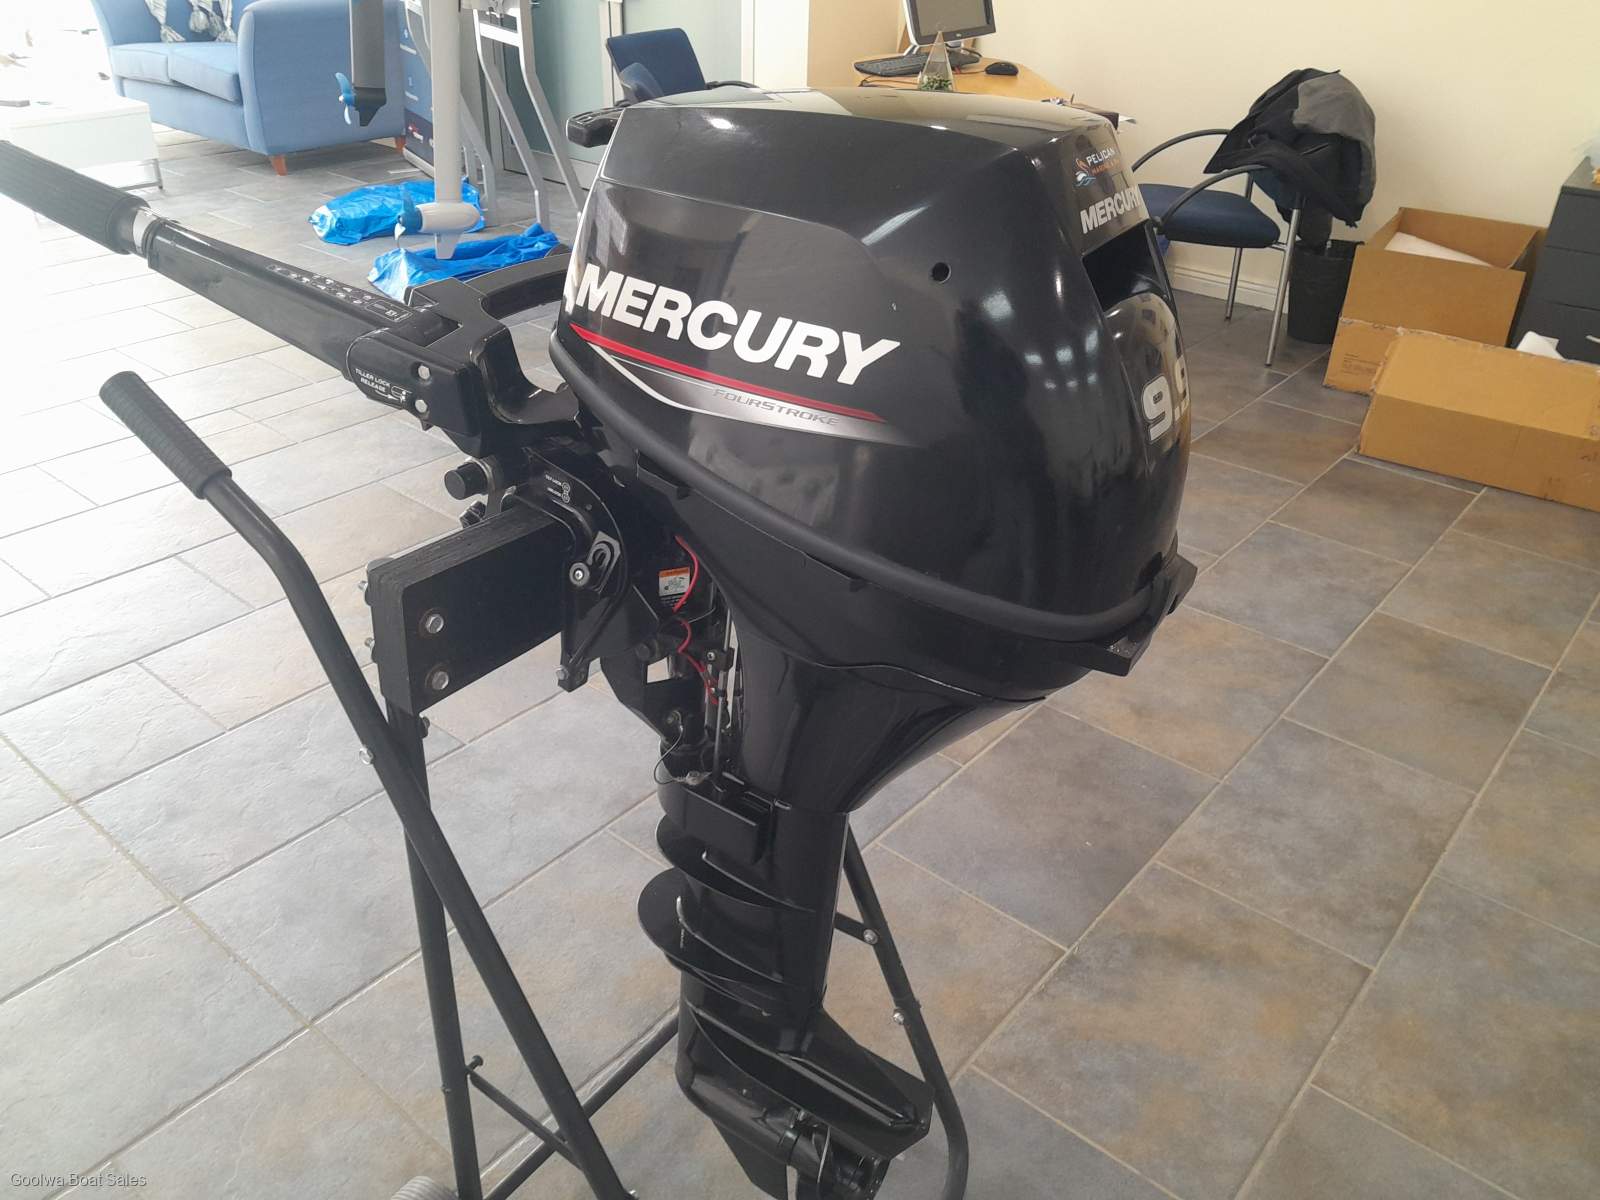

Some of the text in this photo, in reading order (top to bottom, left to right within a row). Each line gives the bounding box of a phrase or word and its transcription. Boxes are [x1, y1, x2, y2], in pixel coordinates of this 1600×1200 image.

[1086, 147, 1116, 167] PELICAN
[575, 263, 900, 386] MERCURY
[712, 388, 840, 426] FOURSTROKE
